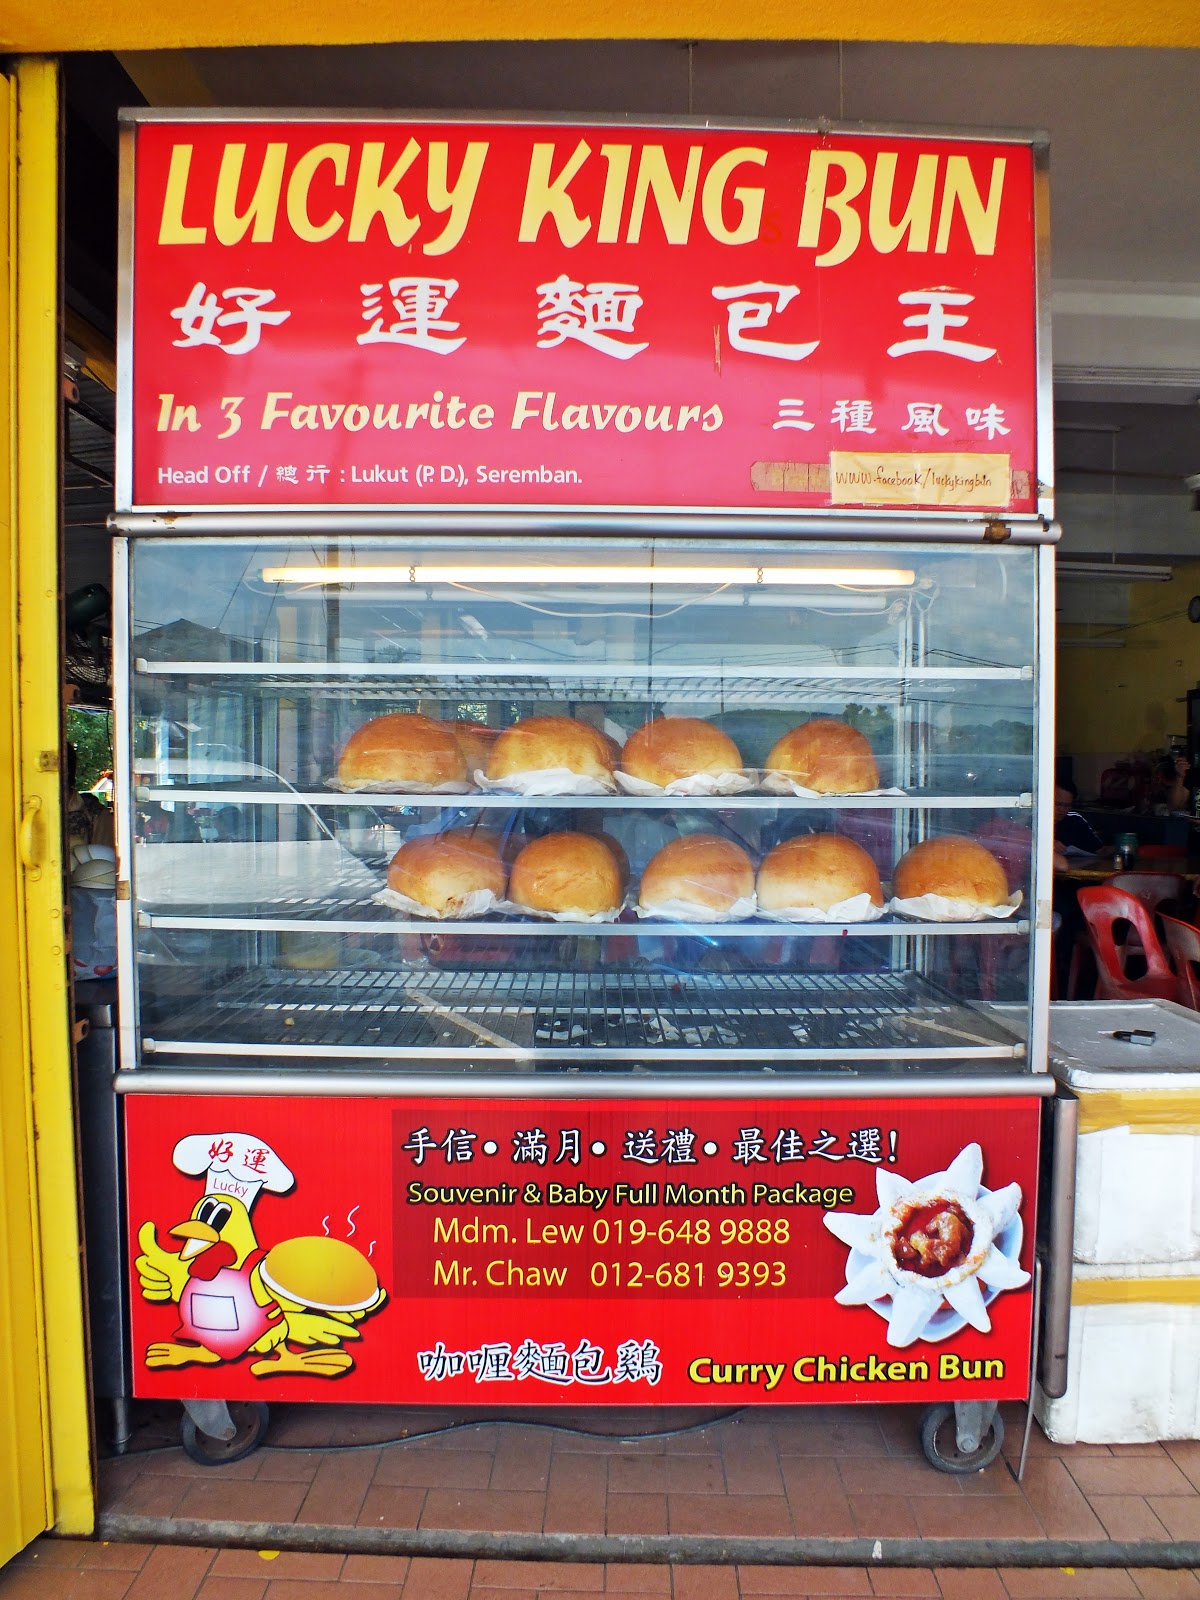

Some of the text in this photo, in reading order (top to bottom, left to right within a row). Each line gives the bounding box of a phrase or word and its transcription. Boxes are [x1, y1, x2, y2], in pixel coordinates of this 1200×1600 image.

[158, 137, 1006, 268] LUCKY KING BUN
[156, 391, 724, 440] In 3 Favourite Flavours
[772, 398, 1012, 441] 三種風味
[158, 466, 209, 484] Head
[215, 465, 251, 484] Off
[351, 465, 409, 484] Lukut
[476, 465, 583, 484] Seremban.
[208, 1138, 270, 1174] 好運
[213, 1178, 249, 1198] Lucky
[409, 1183, 854, 1209] Souvenir & Baby Full Month Package
[433, 1216, 791, 1245] Mdm. Lew 019-648 9888
[433, 1259, 787, 1288] Mr. Chaw 012-681 9393
[689, 1354, 1005, 1389] Curry Chicken Bun
